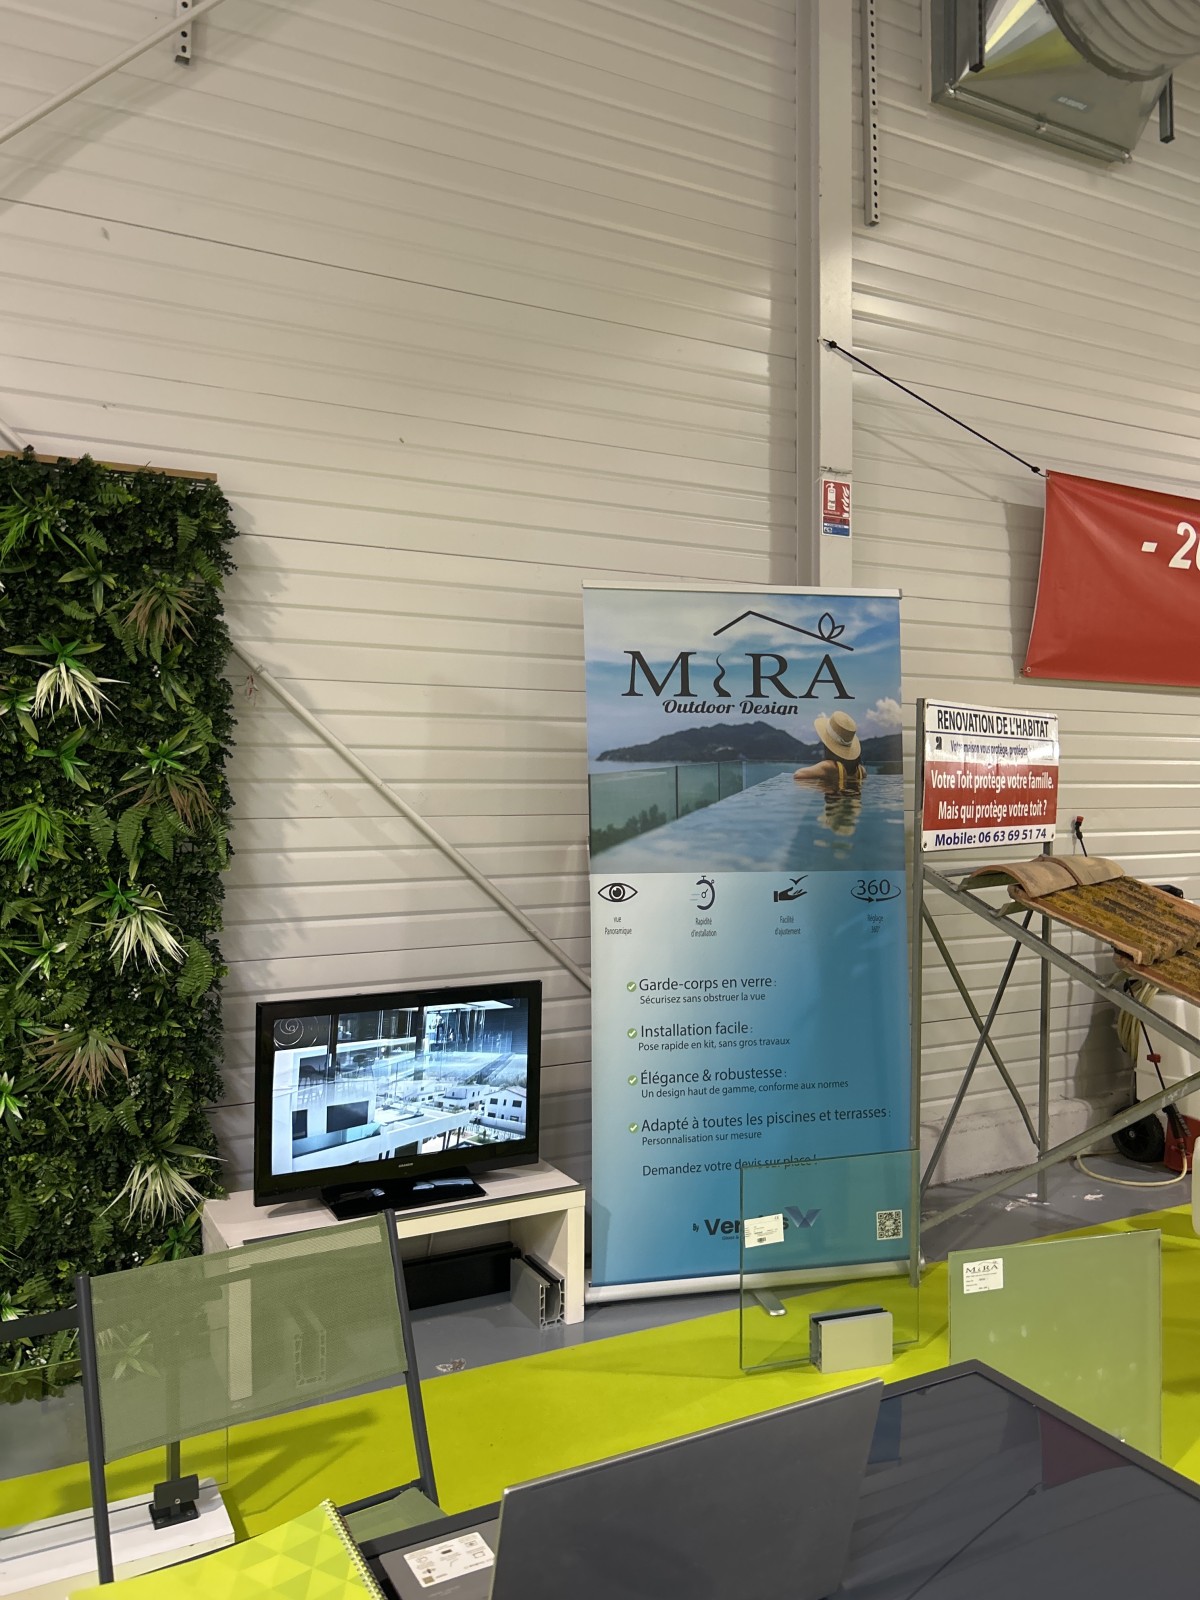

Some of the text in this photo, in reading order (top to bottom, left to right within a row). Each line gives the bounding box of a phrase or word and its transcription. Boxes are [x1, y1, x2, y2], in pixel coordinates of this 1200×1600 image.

[1168, 521, 1200, 573] 2
[662, 699, 799, 716] Outdoor Design
[937, 710, 1049, 738] RENOVATION DE L'HABITAT
[980, 744, 991, 755] vous
[931, 770, 1054, 794] Votre Toit protège votre famille.
[938, 801, 958, 820] Mais
[960, 801, 975, 823] qui
[975, 800, 1007, 823] protège
[1008, 801, 1029, 816] votre
[1029, 799, 1043, 816] toit
[935, 828, 1047, 847] Mobile: 06 63 69 51 74
[857, 879, 891, 895] 360
[695, 917, 713, 925] Rapidité
[604, 927, 633, 935] Panoramique
[639, 978, 719, 991] Garde-corps
[721, 979, 738, 988] en
[640, 992, 766, 1004] Sécurisez sans obstruer la vue
[641, 1023, 712, 1038] Installation
[638, 1042, 660, 1051] Pose
[661, 1041, 690, 1052] rapide
[703, 1039, 717, 1049] kit,
[718, 1040, 738, 1048] sans
[739, 1040, 758, 1049] gros
[759, 1037, 791, 1046] travaux
[641, 1070, 699, 1087] Élégance
[702, 1069, 712, 1082] &
[641, 1080, 849, 1099] Un design haut de gamme, conforme aux normes
[641, 1117, 689, 1134] Adapté
[692, 1116, 700, 1129] à
[703, 1115, 743, 1129] toutes
[746, 1113, 763, 1126] les
[766, 1110, 816, 1127] piscines
[819, 1109, 831, 1121] et
[642, 1131, 762, 1146] Personnalisation sur mesure
[642, 1163, 702, 1176] Demandez
[704, 1161, 732, 1172] votre
[734, 1158, 762, 1170] devis
[692, 1223, 699, 1232] By
